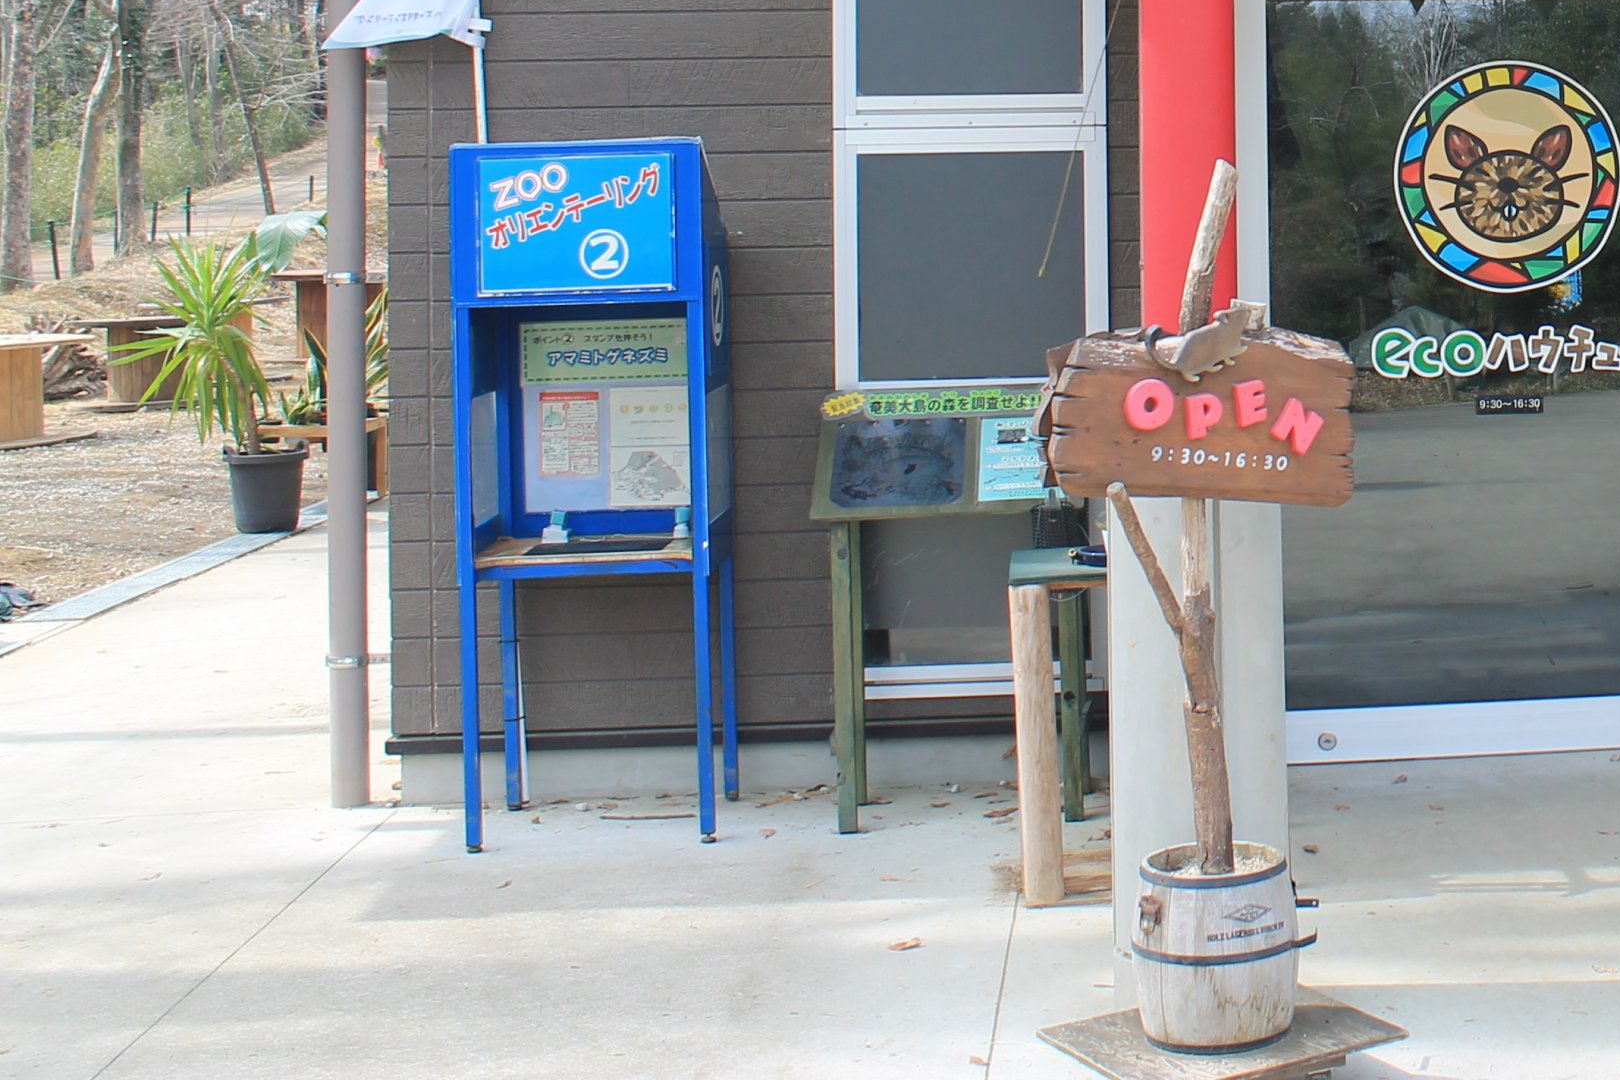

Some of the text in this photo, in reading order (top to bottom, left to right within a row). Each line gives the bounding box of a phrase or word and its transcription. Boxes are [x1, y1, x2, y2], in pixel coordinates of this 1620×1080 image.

[486, 163, 660, 248] オリエンテーリング
[490, 162, 568, 210] ZOO
[547, 347, 669, 368] アマミトゲネズミ
[1123, 378, 1325, 456] OPEN
